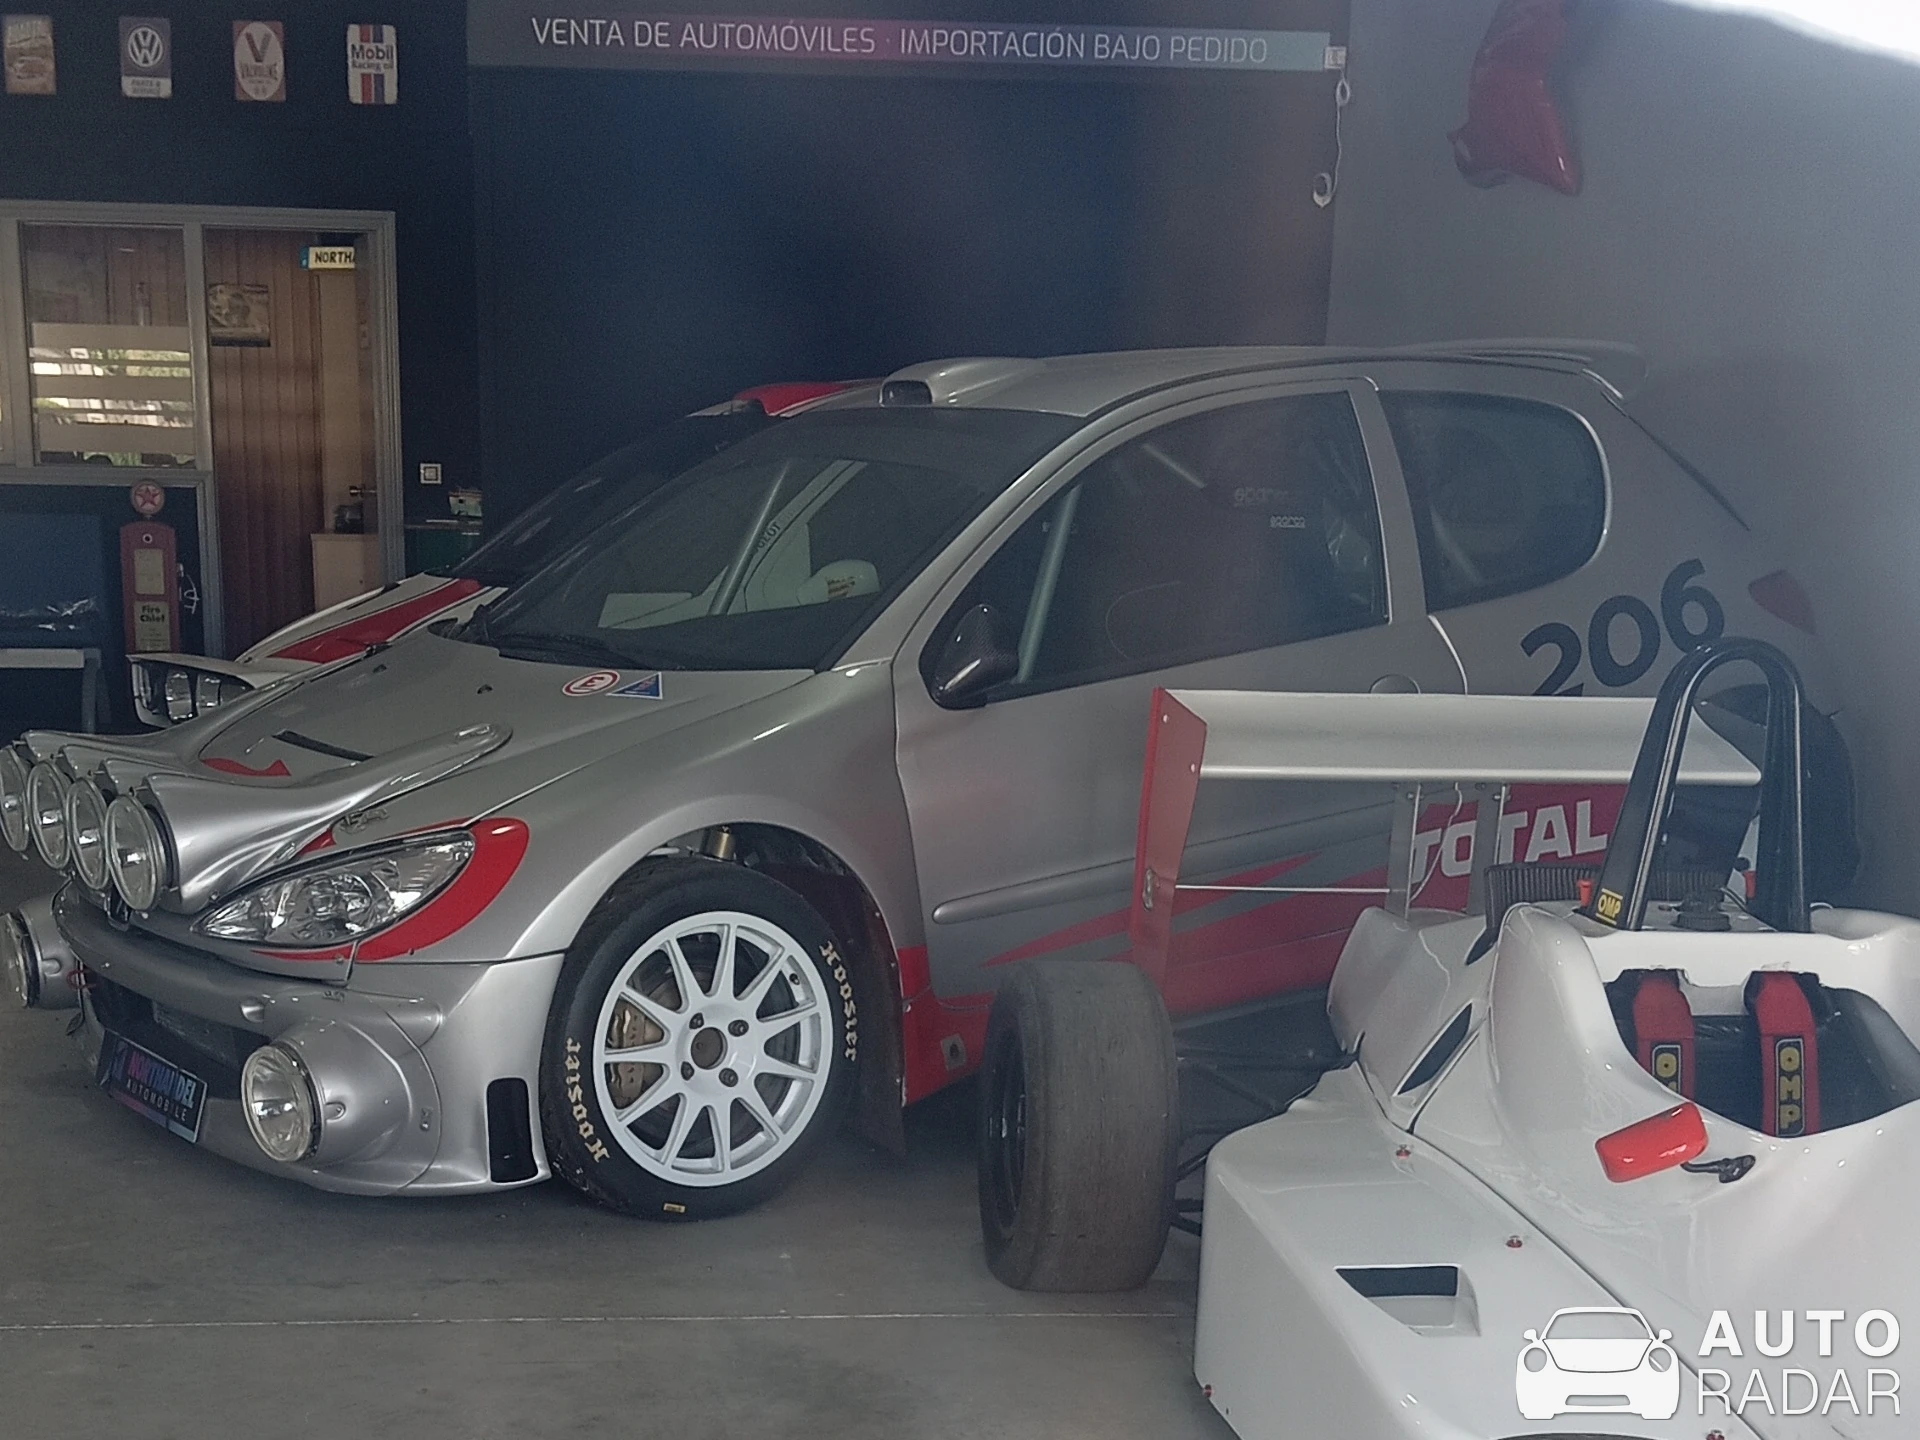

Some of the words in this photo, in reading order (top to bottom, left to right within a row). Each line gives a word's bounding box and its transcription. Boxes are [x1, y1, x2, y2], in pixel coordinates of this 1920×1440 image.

[351, 44, 394, 60] Mobil
[532, 18, 625, 46] VENTA
[634, 22, 671, 48] DE
[679, 20, 876, 53] AUTOMÓVILES
[900, 27, 1085, 59] IMPORTACIÓN
[1094, 33, 1161, 61] BAJO
[1170, 36, 1268, 64] PEDIDO
[315, 251, 355, 264] NORTH
[1521, 558, 1725, 697] 206
[1410, 800, 1608, 884] TOTAL
[1598, 894, 1621, 918] OMP
[1779, 1046, 1802, 1130] OMP
